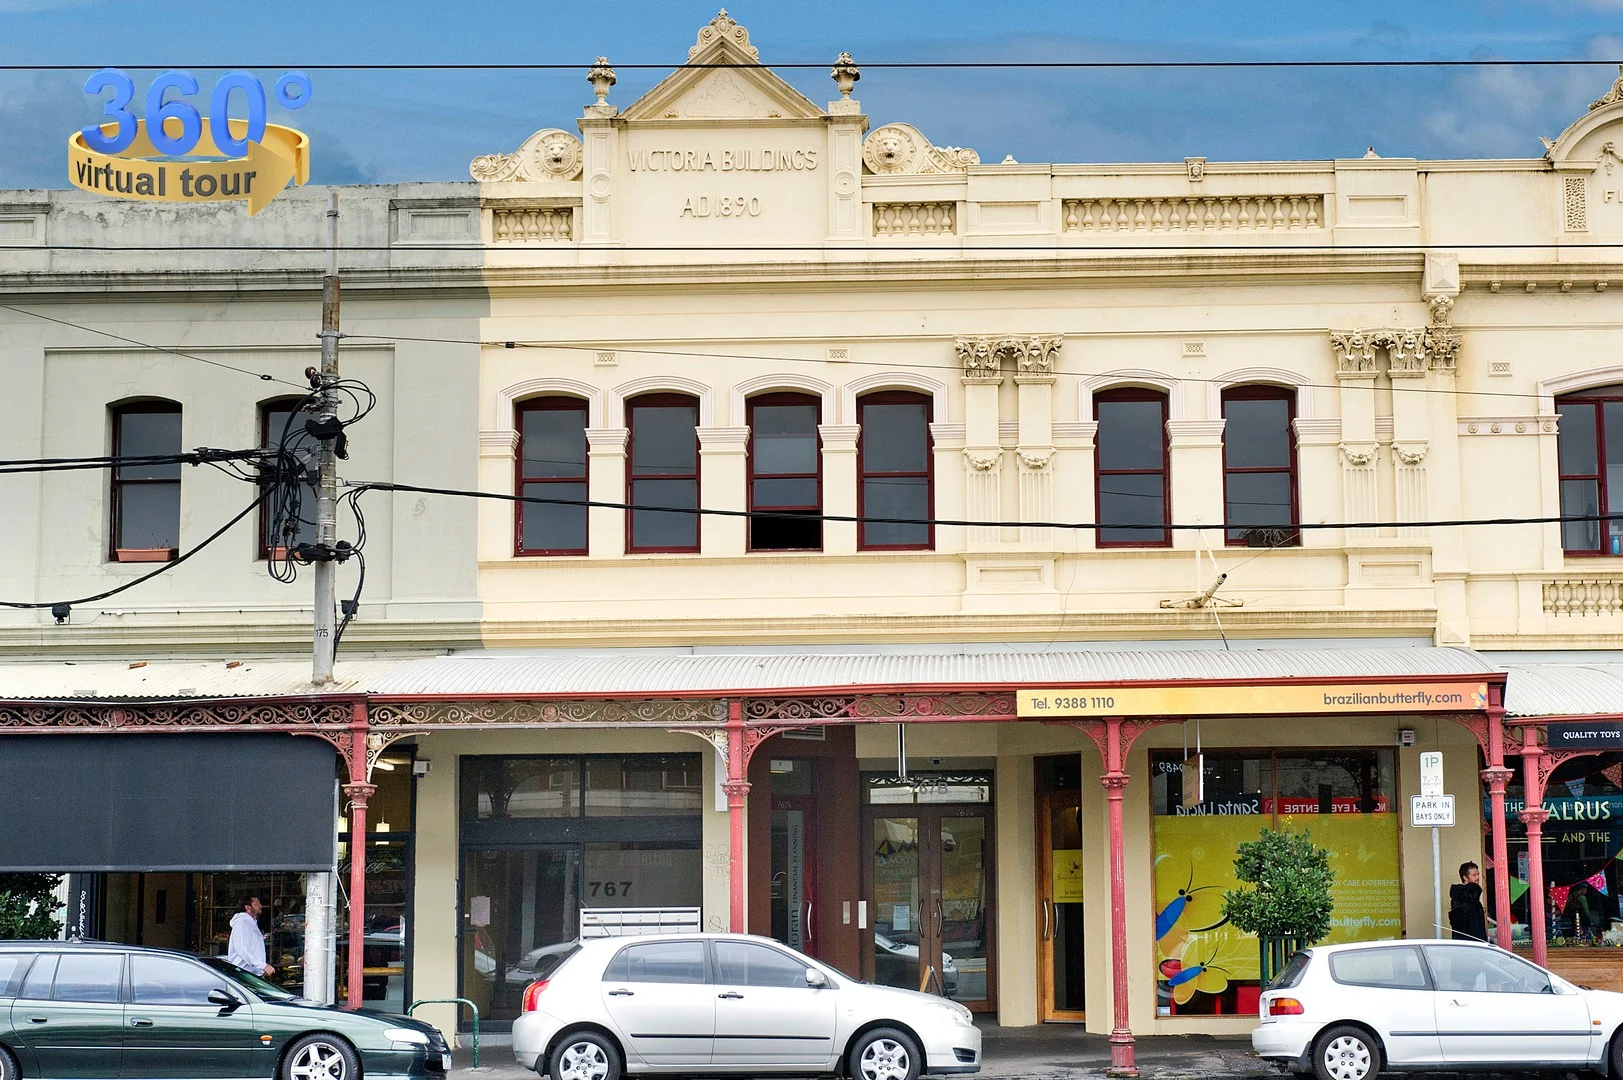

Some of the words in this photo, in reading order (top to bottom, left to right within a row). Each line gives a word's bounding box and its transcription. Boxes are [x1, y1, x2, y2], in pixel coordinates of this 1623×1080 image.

[628, 149, 717, 171] VICTORIA
[721, 149, 818, 171] BUILDINGS
[715, 196, 762, 217] 1890
[1031, 697, 1051, 709] Tel.
[1054, 697, 1087, 709] 9388
[1091, 697, 1115, 709] 1110
[1323, 691, 1462, 706] brazilianbutterfly.com
[1563, 731, 1598, 739] QUALITY
[1425, 757, 1439, 768] 1P
[1416, 801, 1437, 809] PARK
[1442, 801, 1450, 809] IN
[1504, 802, 1524, 812] THE
[1416, 812, 1433, 820] BAYS
[1434, 812, 1450, 820] ONLY
[1561, 832, 1585, 843] AND
[1589, 832, 1611, 843] THE
[588, 881, 633, 897] 767
